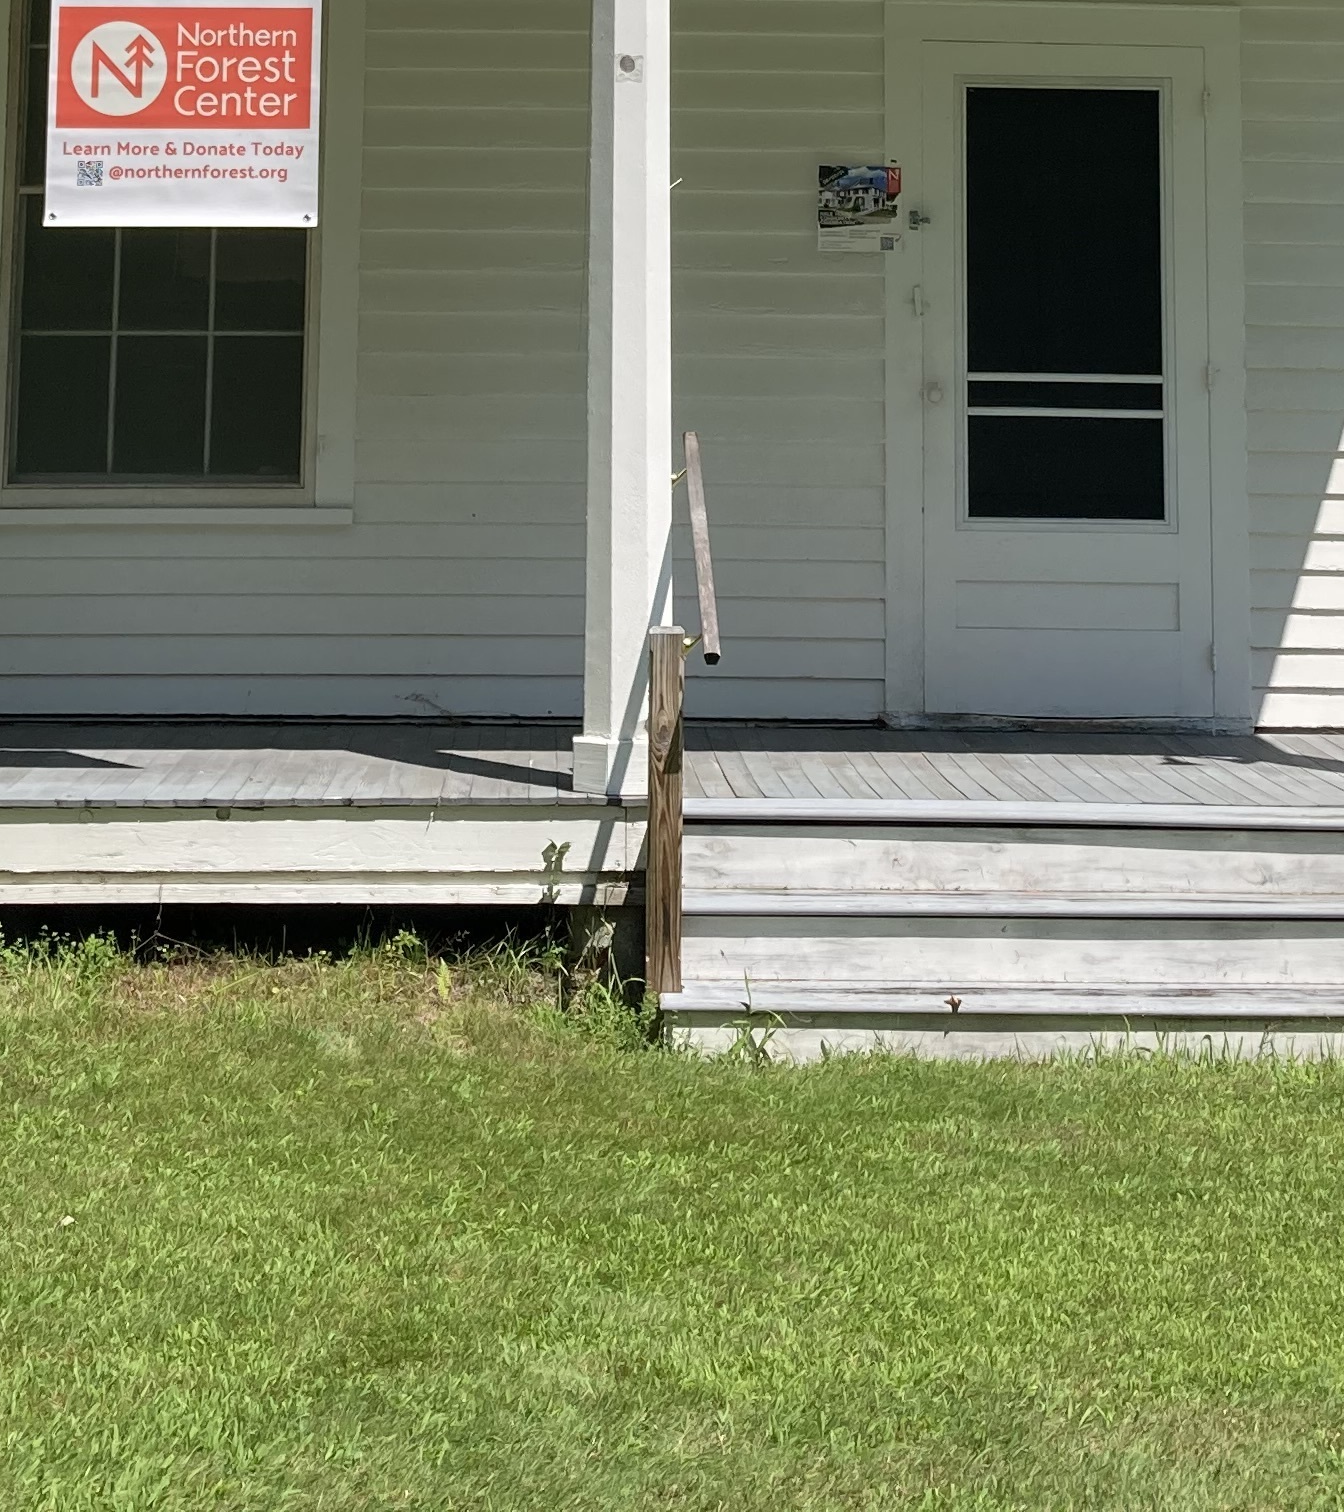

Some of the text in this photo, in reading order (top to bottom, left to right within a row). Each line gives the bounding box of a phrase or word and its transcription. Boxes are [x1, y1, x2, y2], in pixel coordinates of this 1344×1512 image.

[177, 22, 297, 47] Northern
[91, 34, 155, 98] N
[176, 50, 296, 82] Forest
[174, 85, 298, 117] Center
[63, 142, 304, 159] Learn More & Donate Today
[108, 165, 288, 182] @northernforest.org
